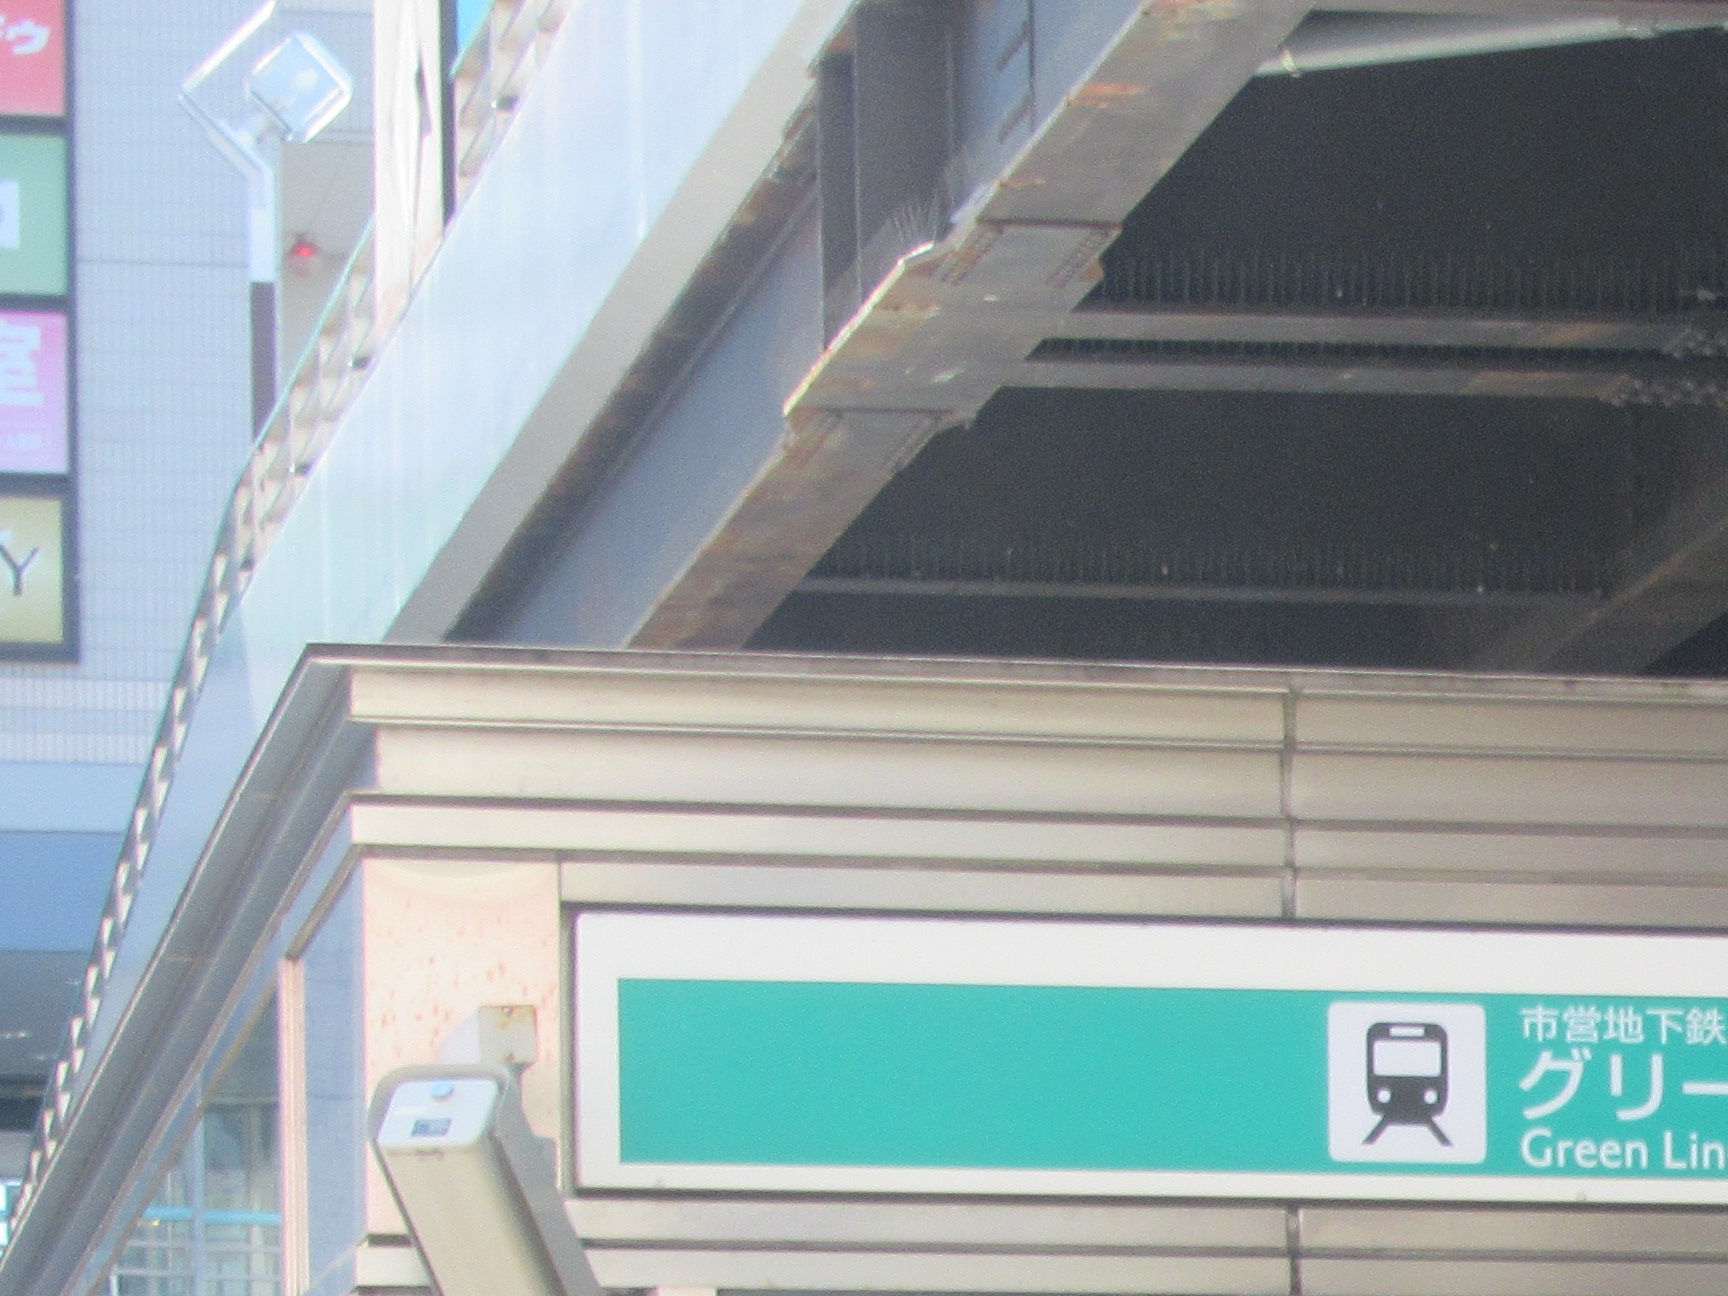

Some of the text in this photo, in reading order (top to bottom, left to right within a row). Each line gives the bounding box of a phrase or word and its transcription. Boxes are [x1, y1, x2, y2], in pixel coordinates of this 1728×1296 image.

[1520, 1005, 1726, 1046] 市営地下鉄
[1520, 1127, 1648, 1169] Green
